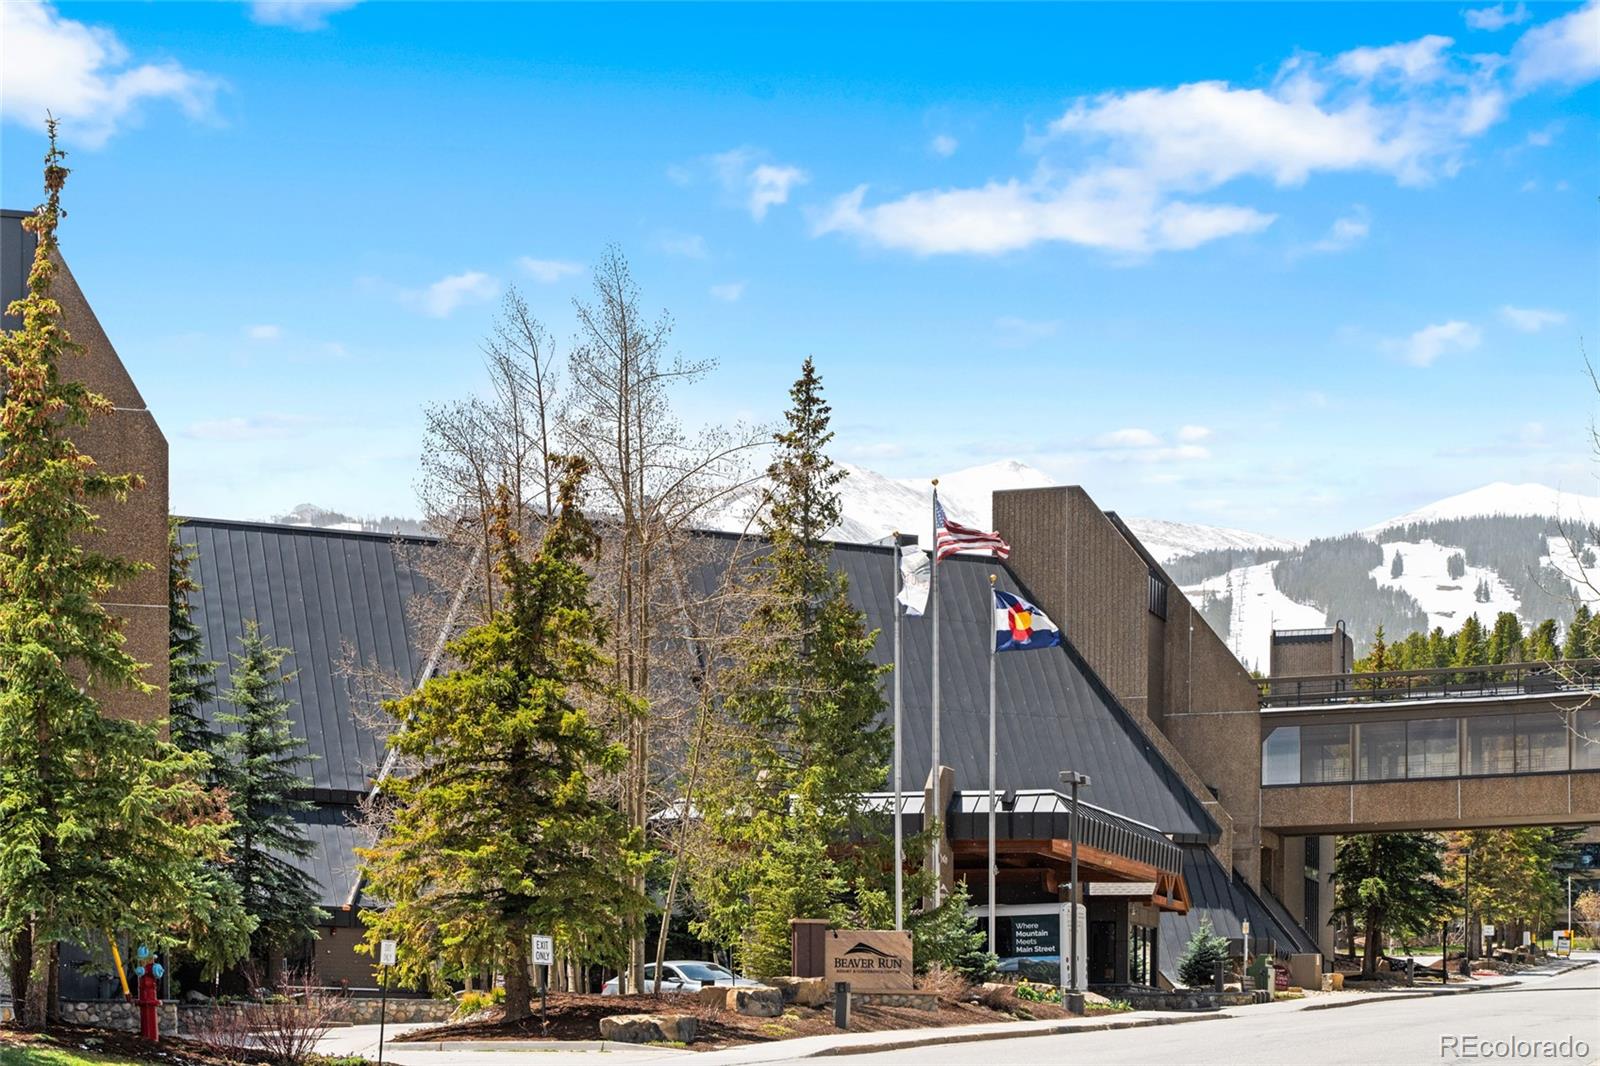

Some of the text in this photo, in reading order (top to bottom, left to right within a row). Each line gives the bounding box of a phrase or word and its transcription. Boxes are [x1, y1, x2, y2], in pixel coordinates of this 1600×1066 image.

[536, 940, 548, 950] EXIT
[1034, 945, 1056, 953] Street
[536, 951, 550, 960] ONLY
[834, 958, 902, 968] BEAVER RUN
